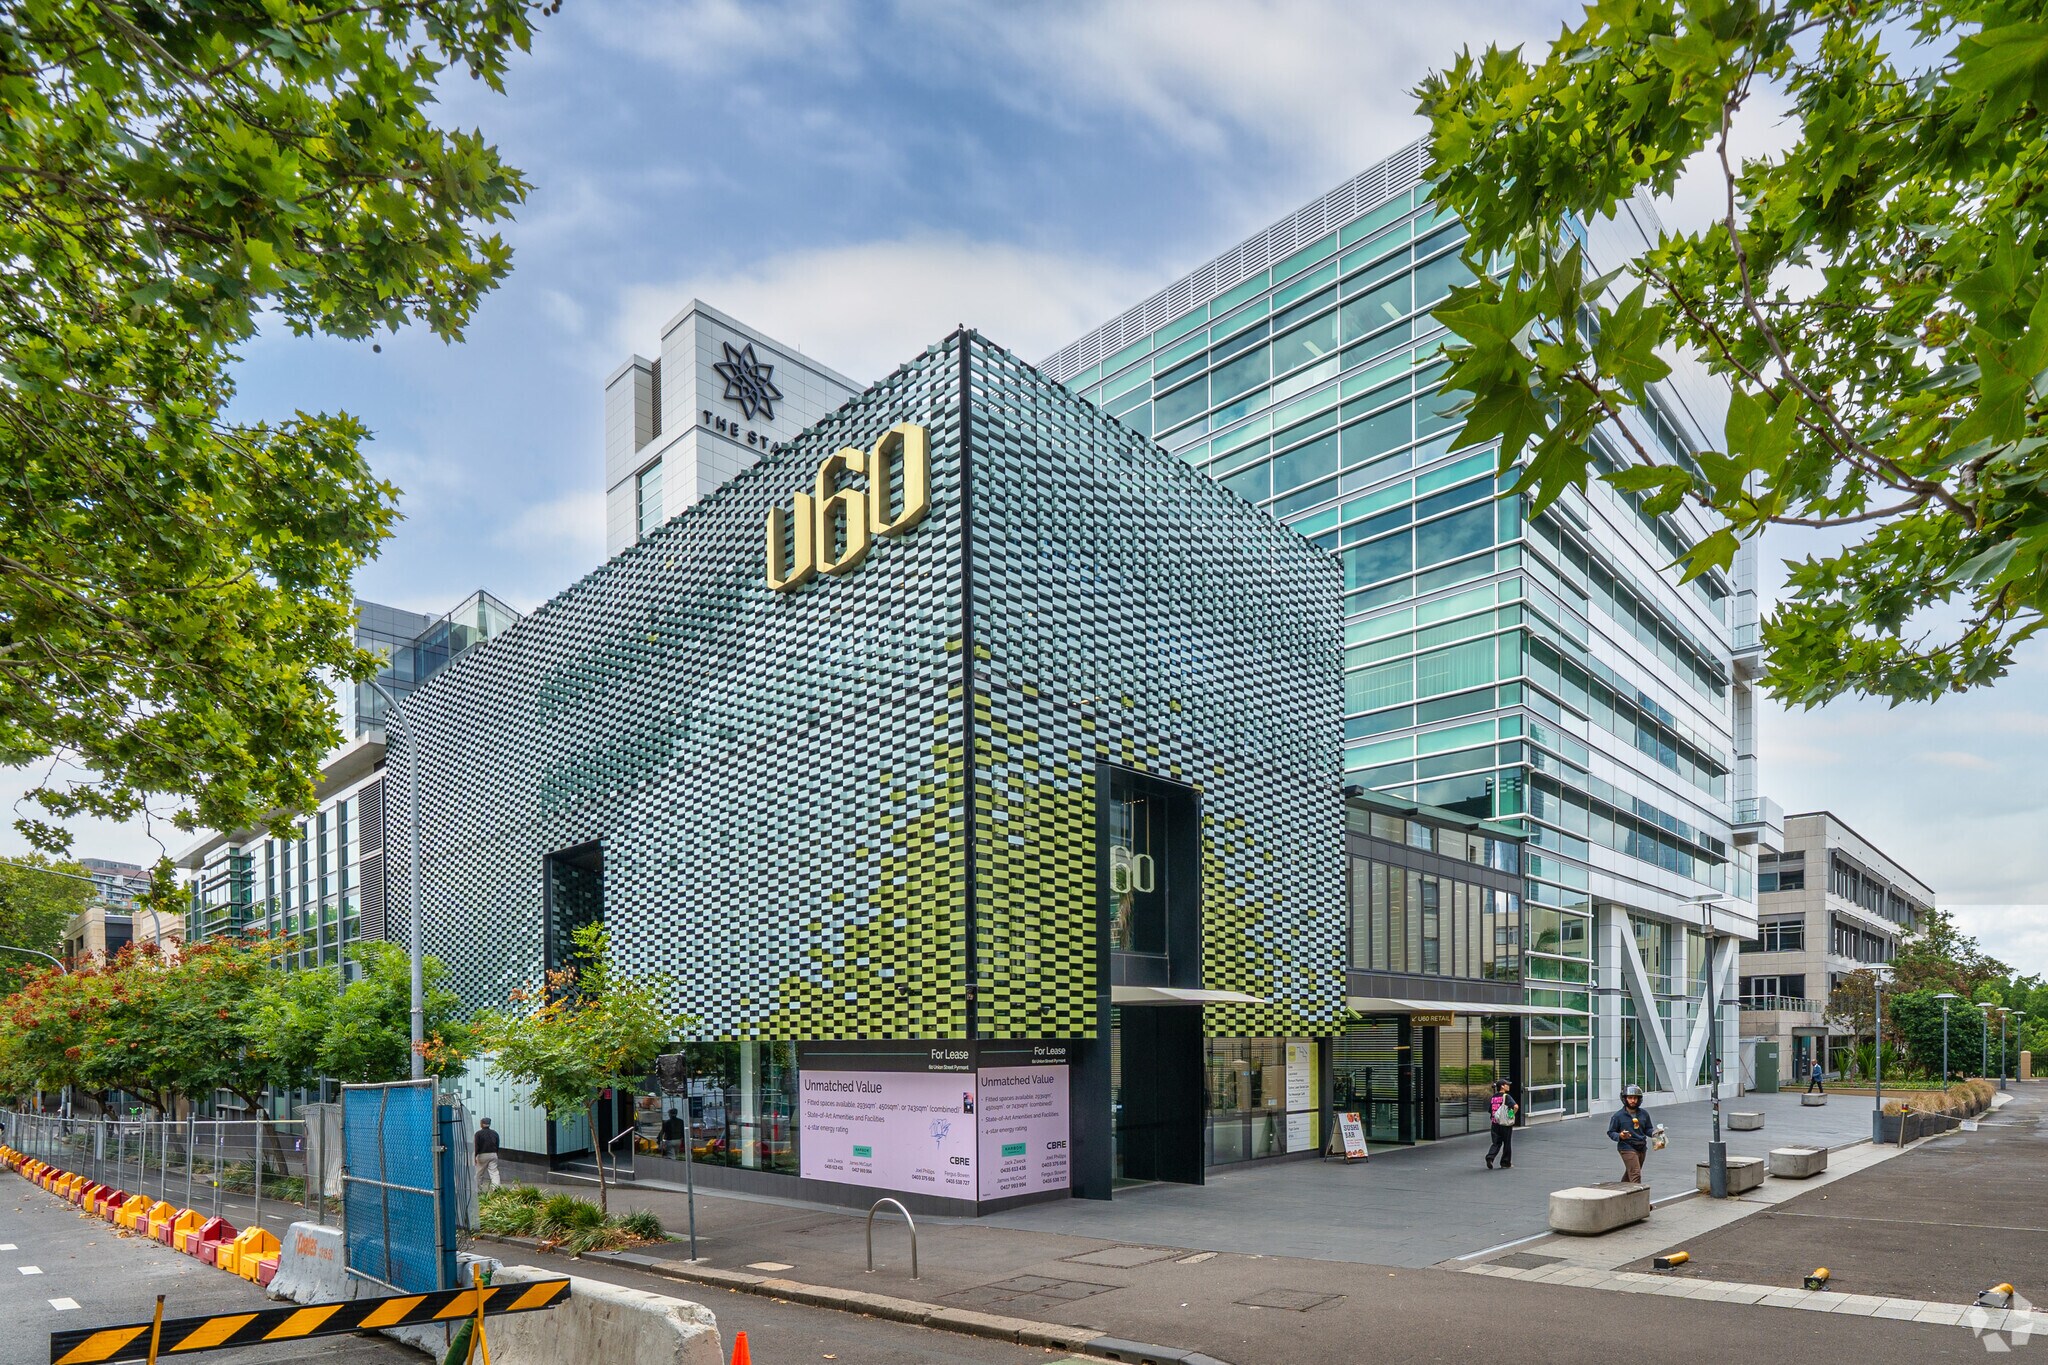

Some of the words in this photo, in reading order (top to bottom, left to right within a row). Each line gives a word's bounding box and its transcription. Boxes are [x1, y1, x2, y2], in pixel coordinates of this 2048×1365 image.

[703, 409, 739, 437] THE
[767, 422, 931, 592] U60
[1110, 844, 1155, 894] 60
[932, 1048, 944, 1060] For
[945, 1049, 969, 1060] Lease
[1034, 1047, 1045, 1055] For
[1046, 1047, 1066, 1055] Lease
[804, 1079, 854, 1092] Unmatched
[856, 1080, 882, 1093] Value
[981, 1075, 1030, 1087] Unmatched
[1032, 1075, 1054, 1084] Value
[836, 1126, 848, 1134] rating
[1047, 1141, 1067, 1149] CBRE
[950, 1156, 970, 1166] CBRE
